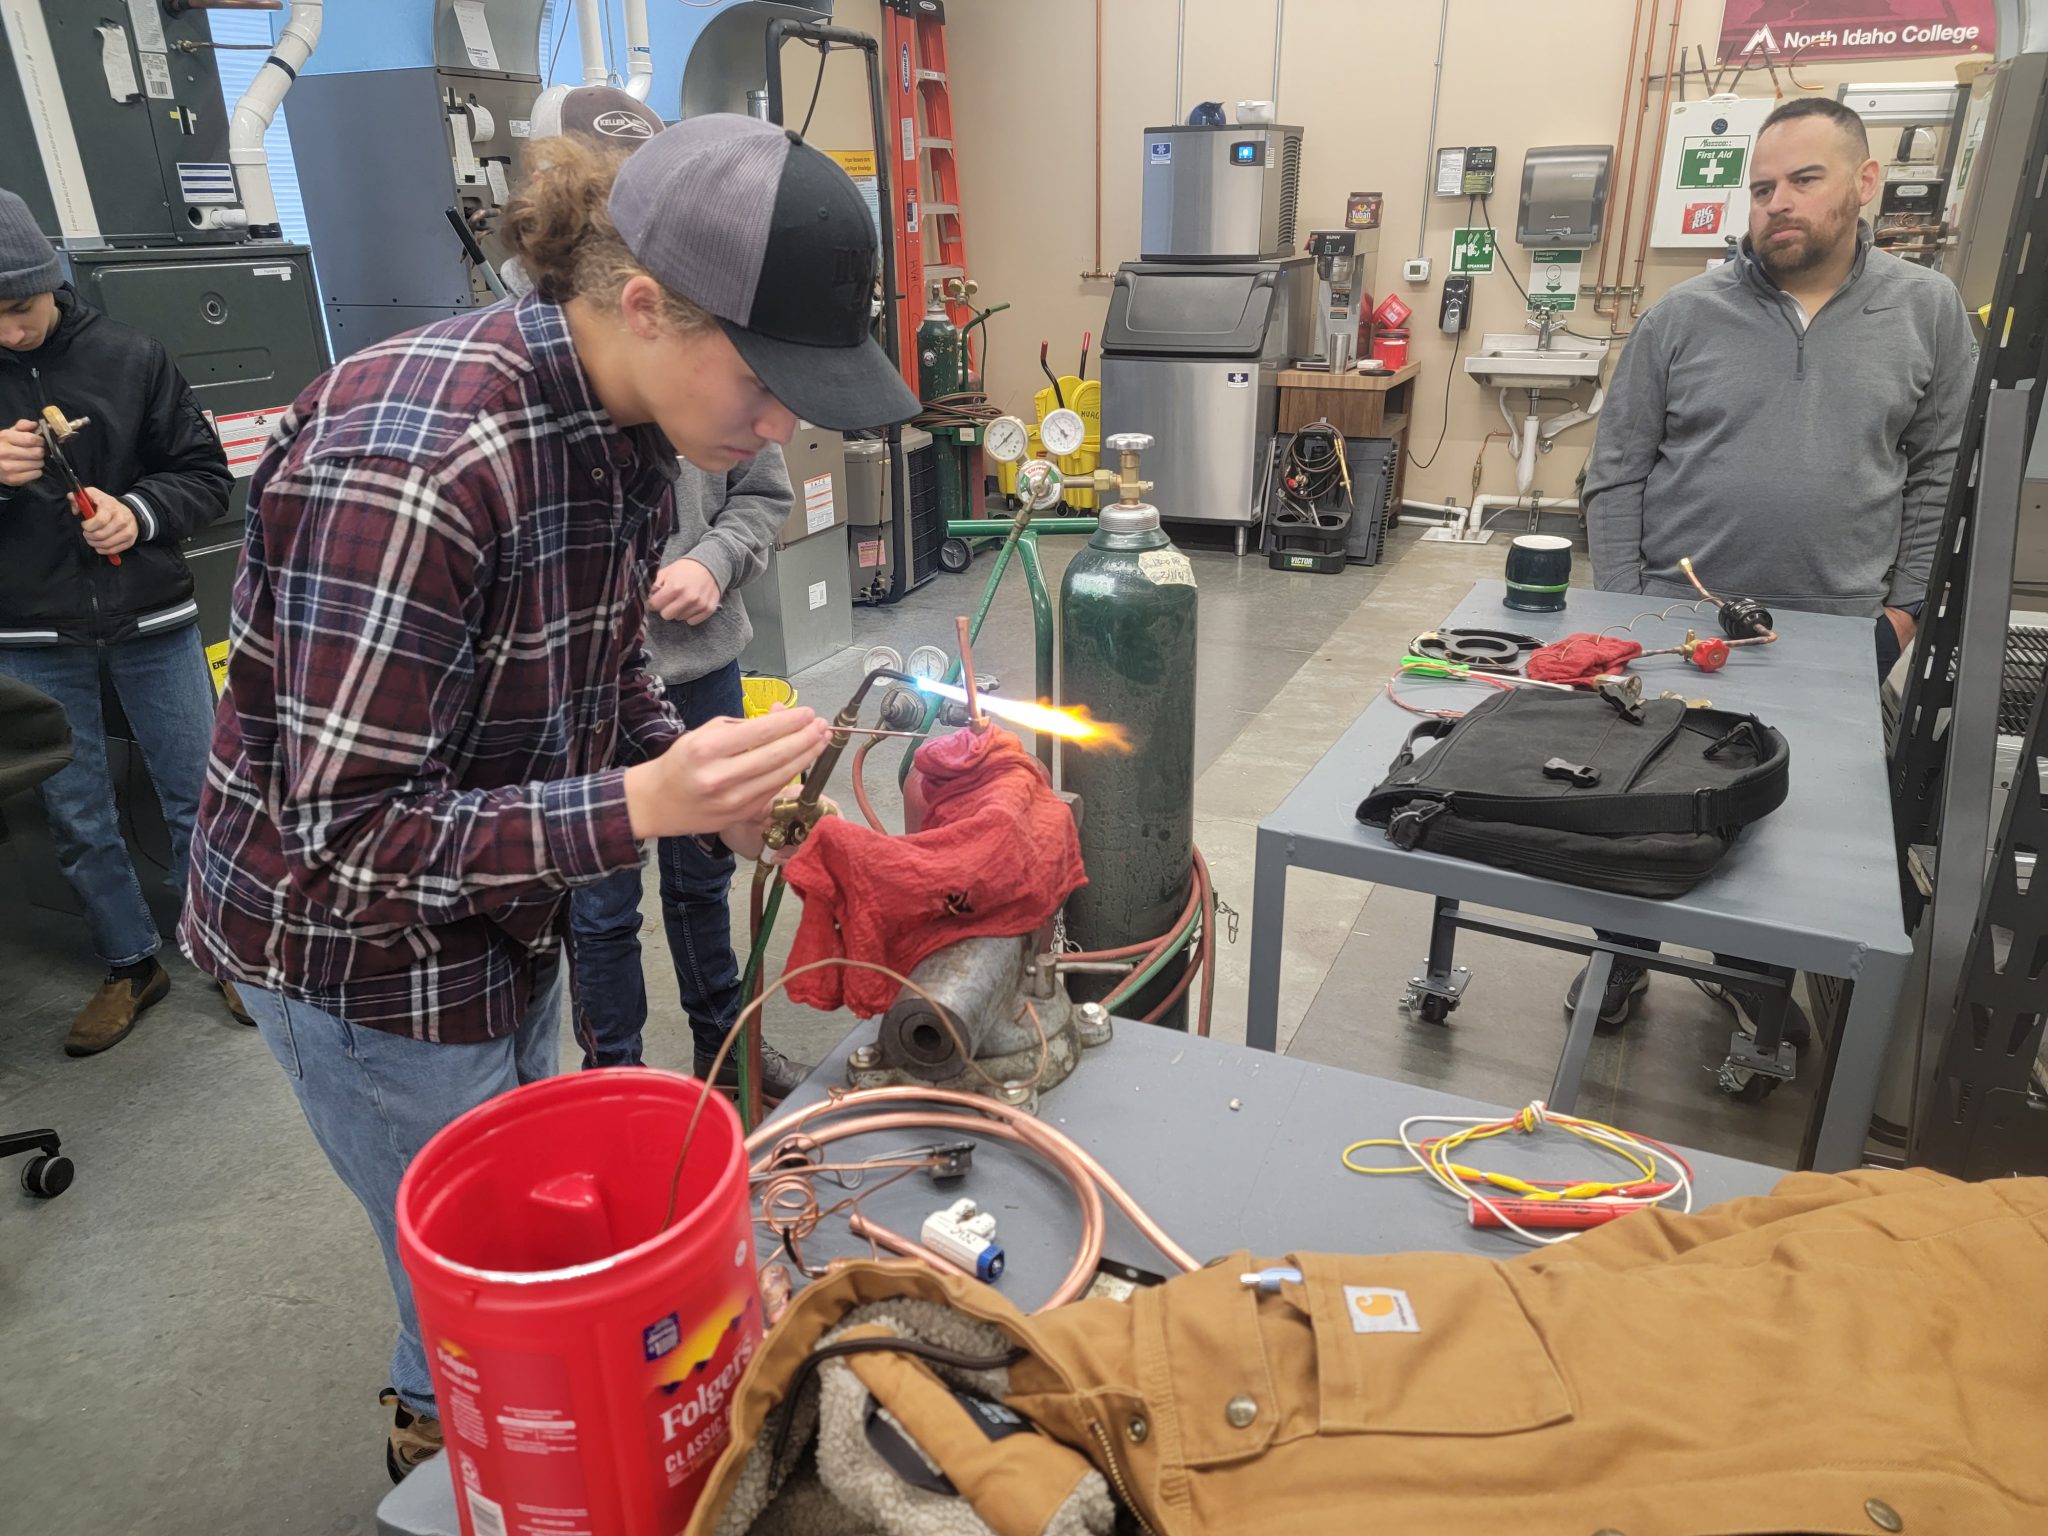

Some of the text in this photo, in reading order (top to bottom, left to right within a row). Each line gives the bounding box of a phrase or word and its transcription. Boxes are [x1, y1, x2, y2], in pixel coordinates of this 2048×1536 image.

[1784, 24, 1980, 48] North Idaho College
[600, 119, 626, 127] KELLER
[1696, 150, 1734, 159] First Aid
[1352, 210, 1371, 219] Yuban
[1695, 205, 1713, 218] BIG
[1692, 214, 1714, 229] RED
[1081, 411, 1100, 420] HVAC
[212, 658, 228, 670] EME
[659, 1341, 753, 1443] Folgers
[665, 1416, 722, 1473] CLASSIC
